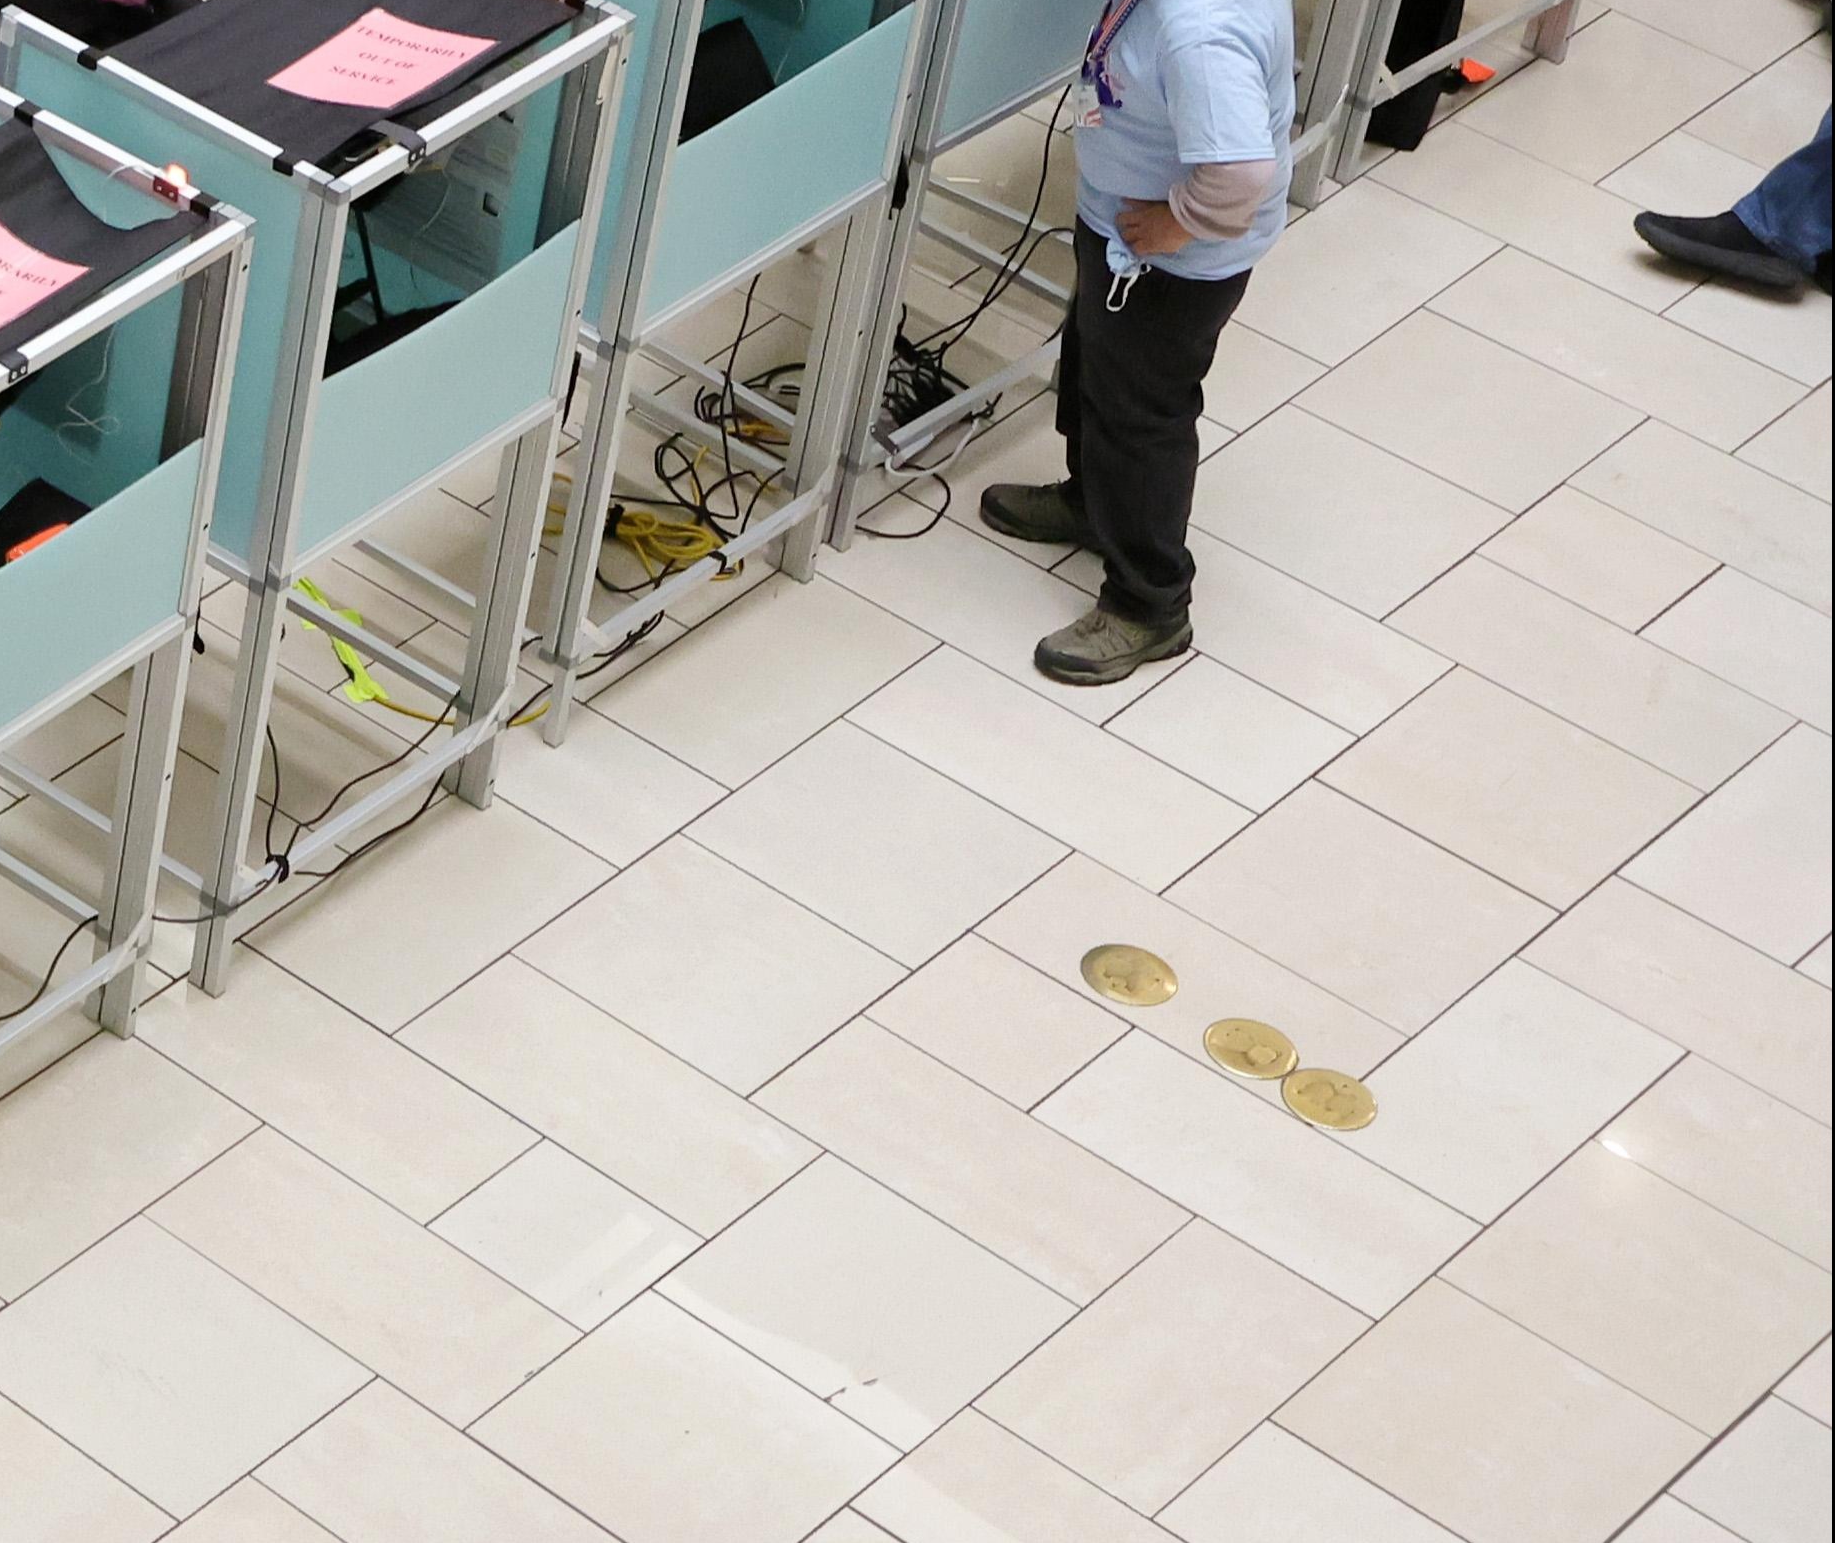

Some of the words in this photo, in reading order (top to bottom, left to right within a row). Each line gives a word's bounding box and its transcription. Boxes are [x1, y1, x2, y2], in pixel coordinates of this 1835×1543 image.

[356, 24, 467, 60] TEMPORARILY
[357, 51, 397, 66] OUT
[396, 60, 415, 70] OF
